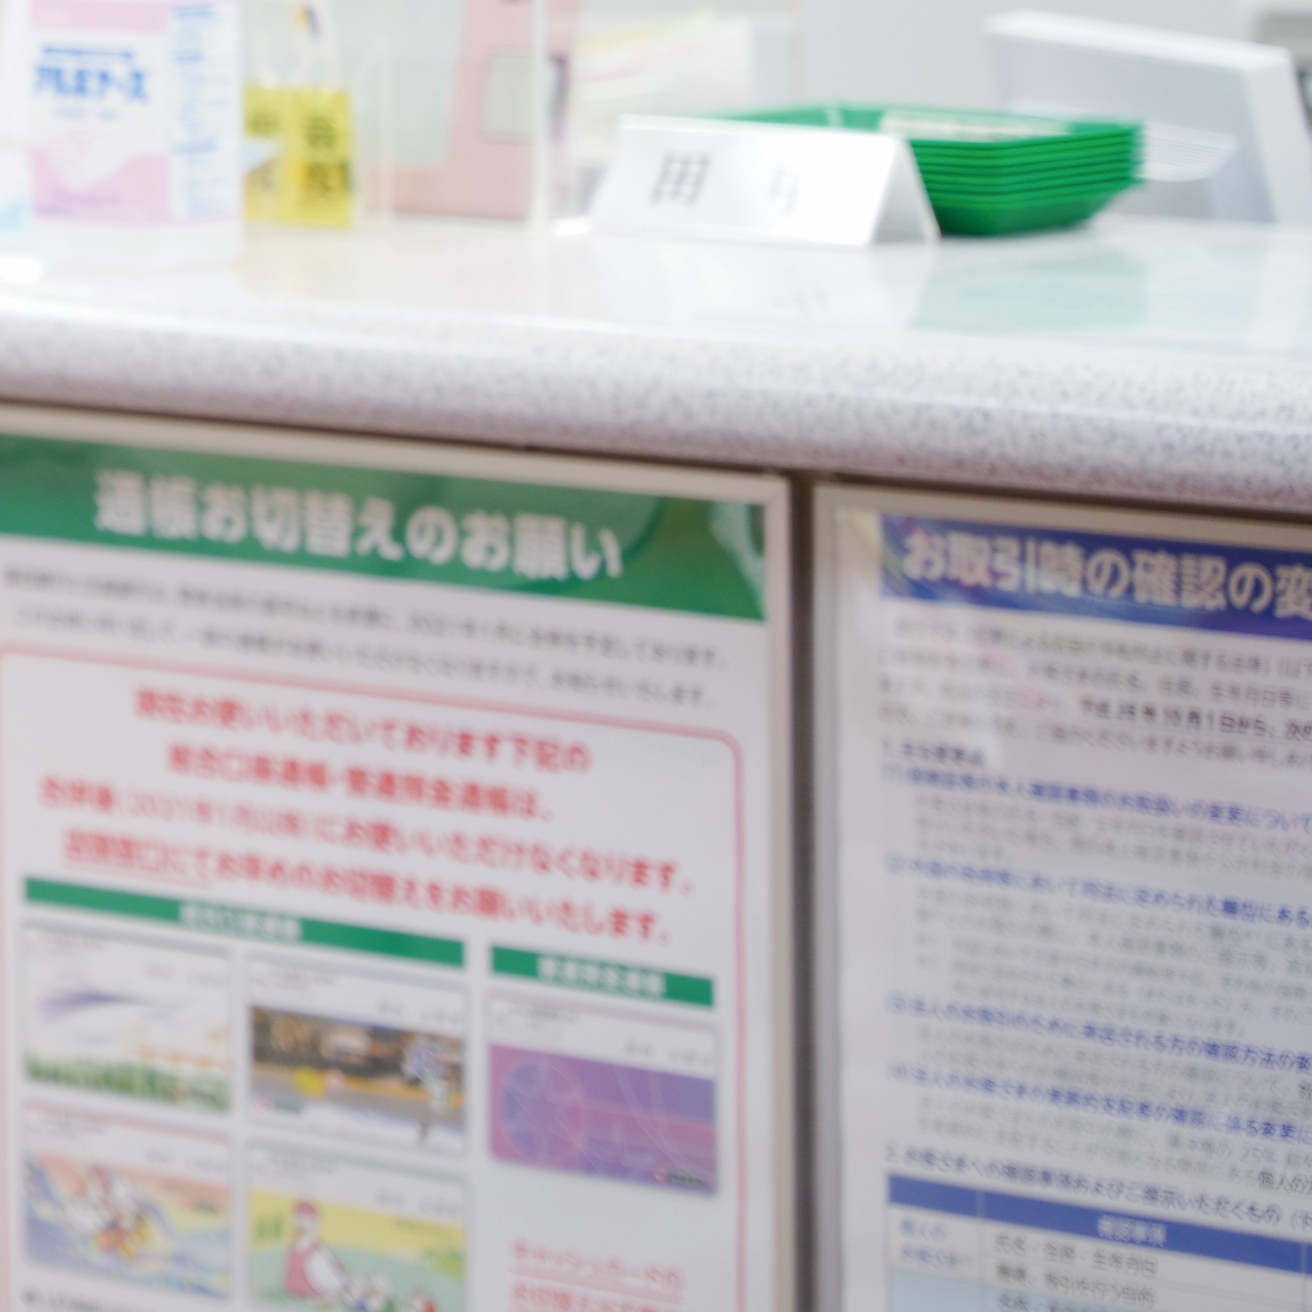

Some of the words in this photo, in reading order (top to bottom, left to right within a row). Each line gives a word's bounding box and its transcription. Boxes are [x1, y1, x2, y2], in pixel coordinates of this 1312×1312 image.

[94, 469, 624, 583] 通帳お切替えのお願い
